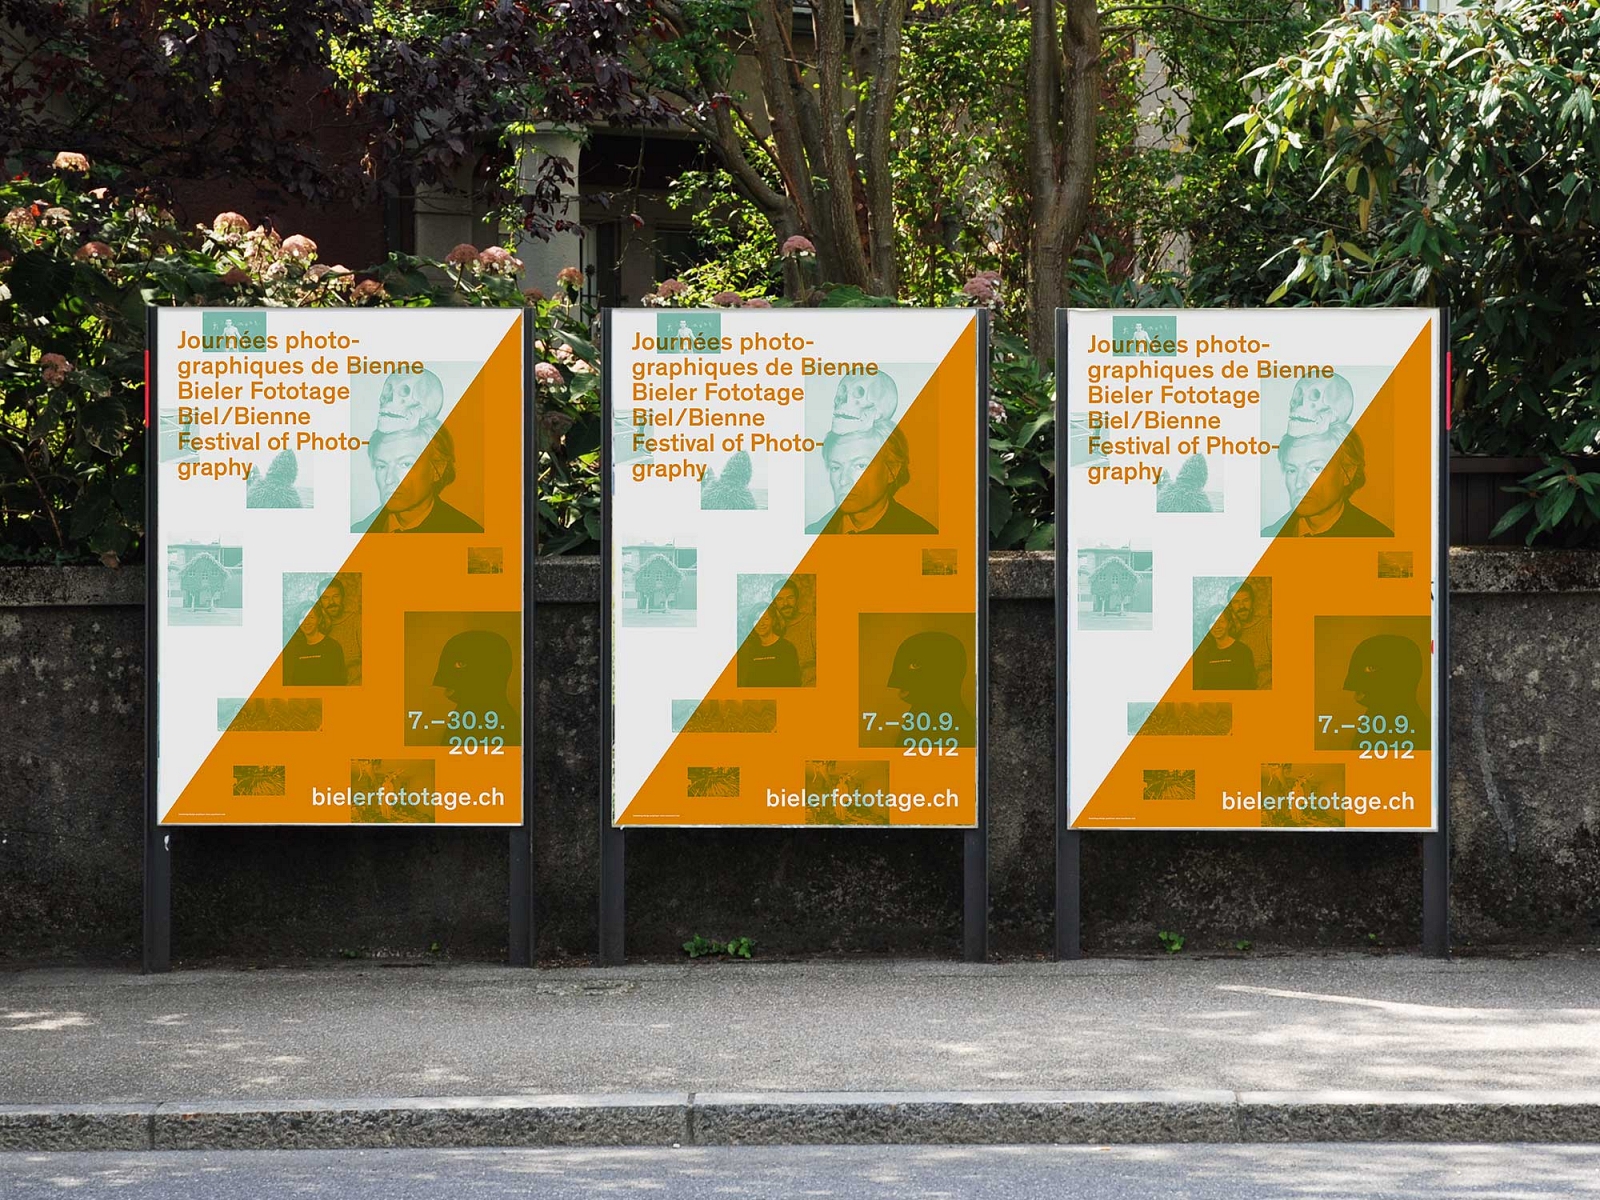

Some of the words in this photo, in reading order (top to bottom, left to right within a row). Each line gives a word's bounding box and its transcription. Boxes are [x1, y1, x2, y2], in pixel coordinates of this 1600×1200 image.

[177, 331, 278, 350] Journées
[285, 331, 360, 354] photo-
[632, 332, 733, 352] Journées
[740, 332, 815, 356] photo-
[1087, 335, 1188, 354] Journées
[1195, 335, 1270, 358] photo-
[177, 356, 304, 378] graphiques
[312, 356, 339, 374] de
[347, 356, 424, 374] Bienne
[632, 358, 759, 380] graphiques
[767, 358, 794, 376] de
[802, 358, 879, 376] Bienne
[1087, 360, 1214, 382] graphiques
[1222, 360, 1249, 378] de
[1257, 360, 1334, 378] Bienne
[178, 381, 243, 400] Bieler
[250, 381, 350, 404] Fototage
[633, 382, 698, 402] Bieler
[705, 382, 805, 406] Fototage
[1088, 385, 1153, 404] Bieler
[1160, 385, 1260, 408] Fototage
[178, 406, 311, 425] Biel/Bienne
[633, 408, 766, 426] Biel/Bienne
[1088, 410, 1221, 429] Biel/Bienne
[178, 431, 260, 450] Festival
[267, 431, 290, 450] of
[296, 431, 370, 450] Photo-
[633, 432, 715, 452] Festival
[722, 432, 745, 452] of
[751, 432, 825, 452] Photo-
[1088, 435, 1170, 454] Festival
[1177, 435, 1200, 454] of
[1206, 435, 1280, 454] Photo-
[177, 457, 253, 481] graphy
[632, 458, 708, 482] graphy
[1087, 461, 1163, 485] graphy
[449, 736, 505, 755] 2012
[904, 738, 960, 756] 2012
[1359, 740, 1415, 759] 2012
[312, 787, 505, 811] bielerfototage.ch
[767, 788, 960, 812] bielerfototage.ch
[1222, 791, 1415, 815] bielerfototage.ch
